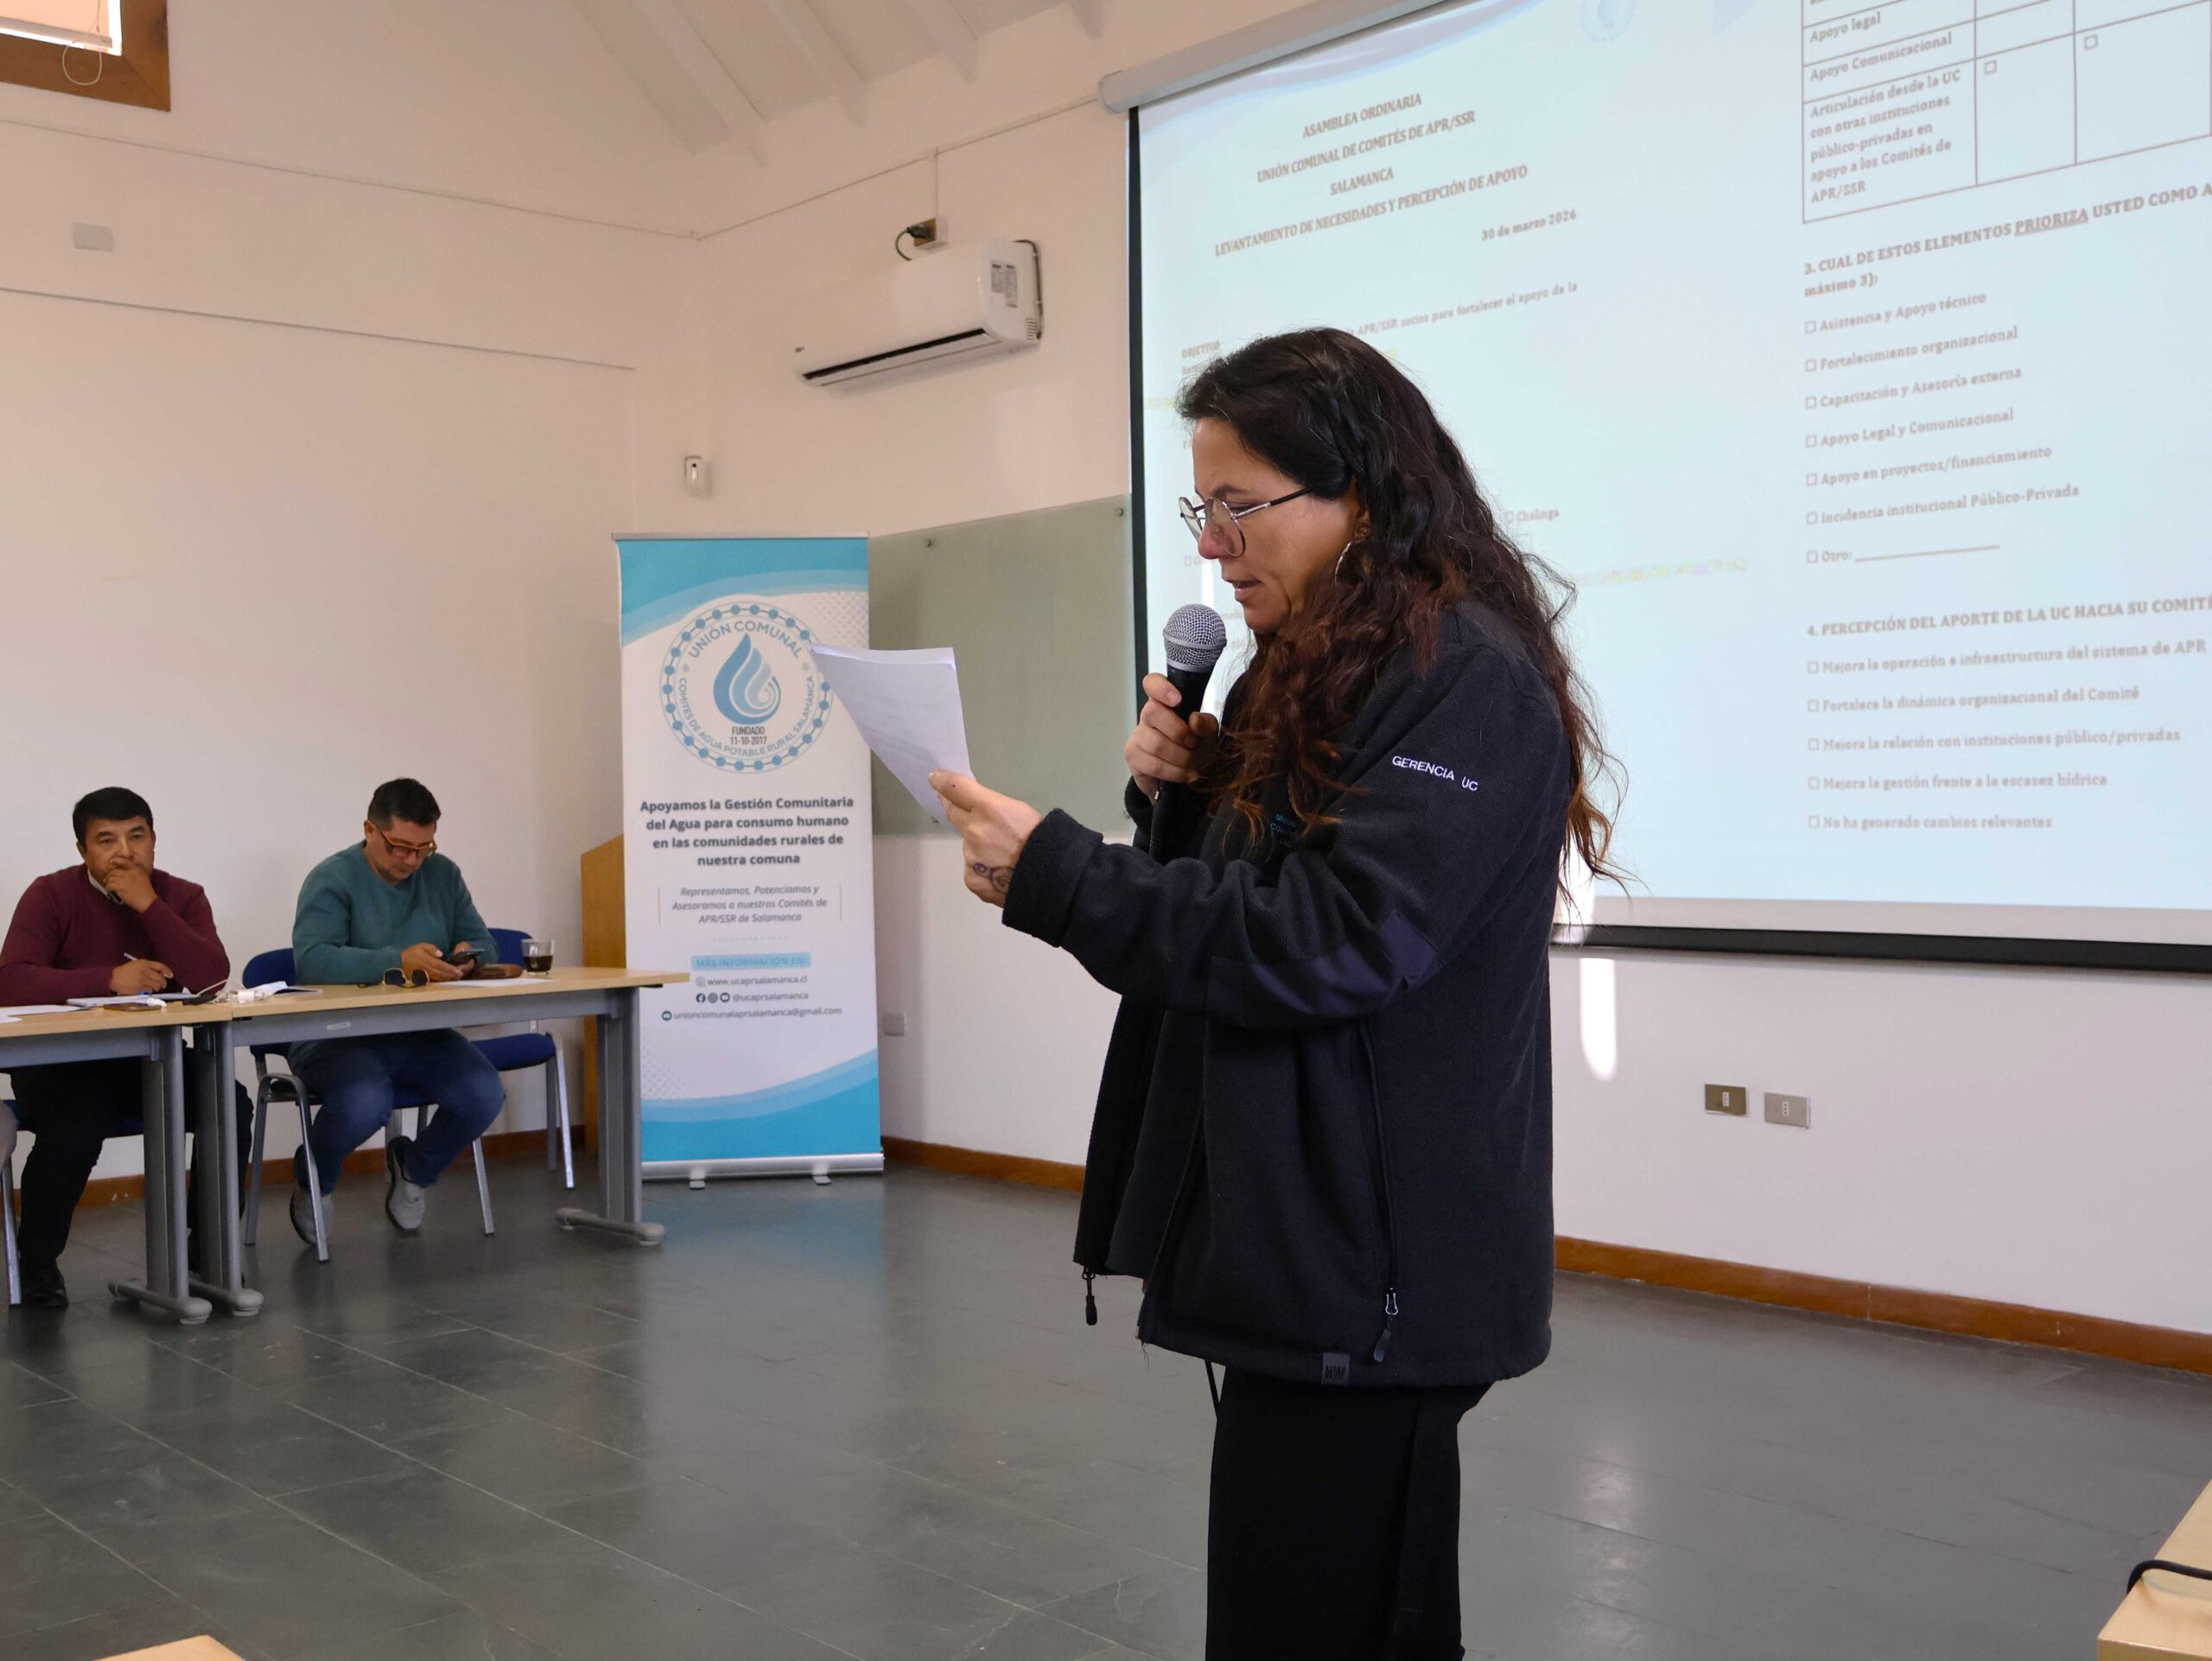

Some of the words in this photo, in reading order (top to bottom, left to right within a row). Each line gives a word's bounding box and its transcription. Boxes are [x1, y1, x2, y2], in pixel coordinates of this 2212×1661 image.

[1810, 23, 1848, 42] Apoyo
[1851, 10, 1880, 30] legal
[1810, 62, 1848, 80] Apoyo
[1852, 34, 1951, 69] Comunicacional
[1810, 90, 1884, 117] Articulación
[1887, 79, 1924, 99] desde
[1927, 75, 1939, 88] la
[1942, 68, 1960, 84] UC
[1302, 111, 1357, 137] ASAMBLEA
[1360, 93, 1421, 120] ORDINARIA
[1810, 125, 1832, 138] con
[1834, 117, 1866, 132] otras
[1869, 96, 1949, 124] instituciones
[1916, 124, 1932, 135] en
[1256, 162, 1289, 182] UNIÓN
[1291, 149, 1340, 173] COMUNAL
[1342, 143, 1357, 158] DE
[1358, 129, 1406, 153] COMITÉS
[1408, 124, 1424, 140] DE
[1425, 111, 1475, 135] APR/SSR
[1811, 164, 1847, 181] apoyo
[1850, 162, 1857, 172] a
[1859, 156, 1878, 169] los
[1881, 143, 1932, 164] Comités
[1936, 139, 1951, 152] de
[1330, 168, 1393, 194] SALAMANCA
[1811, 180, 1866, 202] APR/SSR
[1215, 224, 1297, 256] LEVANTAMIENTO
[1300, 220, 1313, 234] DE
[1315, 201, 1386, 229] NECESIDADES
[1388, 198, 1395, 212] Y
[1397, 181, 1465, 209] PERCEPCIÓN
[1468, 175, 1484, 191] DE
[1486, 164, 1528, 186] APOYO
[1481, 227, 1494, 240] 30
[1497, 224, 1510, 237] de
[1548, 208, 1576, 225] 2026
[1804, 263, 1815, 275] 3.
[1818, 255, 1853, 271] CUAL
[1856, 250, 1874, 264] DE
[1878, 240, 1921, 260] ESTOS
[1924, 223, 2011, 251] ELEMENTOS
[2014, 208, 2088, 236] PRIORIZA
[2092, 196, 2144, 217] USTED
[2148, 185, 2197, 206] COMO
[1804, 279, 1856, 296] máximo
[1820, 312, 1881, 331] Asistencia
[1884, 310, 1891, 322] y
[1895, 302, 1936, 319] Apoyo
[1939, 293, 1986, 309] técnico
[1820, 346, 1918, 369] Fortalecimiento
[1921, 325, 2018, 353] organizacional
[1820, 385, 1897, 407] Capacitación
[1901, 385, 1908, 398] y
[1911, 373, 1967, 393] Asesoría
[1970, 368, 2021, 385] externa
[1820, 432, 1859, 448] Apoyo
[1862, 423, 1895, 441] Legal
[1897, 425, 1905, 438] y
[1910, 407, 2013, 433] Comunicacional
[1821, 472, 1859, 487] Apoyo
[1862, 469, 1878, 480] en
[1821, 507, 1884, 523] Incidencia
[1887, 495, 1967, 516] institucional
[1807, 625, 1818, 636] 4.
[1821, 616, 1906, 634] PERCEPCIÓN
[1910, 615, 1937, 629] DEL
[1940, 611, 1999, 627] APORTE
[2003, 609, 2023, 623] DE
[2027, 608, 2046, 621] LA
[2050, 606, 2070, 620] UC
[2074, 602, 2124, 618] HACIA
[2127, 601, 2147, 614] SU
[734, 620, 802, 659] COMUNAL
[1822, 661, 1865, 673] Mejora
[1867, 658, 1878, 671] la
[1882, 654, 1946, 671] operación
[1948, 656, 1956, 666] e
[1960, 650, 2063, 665] infraestructura
[2066, 645, 2088, 659] del
[2092, 645, 2148, 659] sistema
[2152, 640, 2171, 655] de
[2174, 639, 2206, 653] APR
[1823, 698, 1879, 711] Fortalece
[1882, 696, 1893, 710] la
[1896, 695, 1955, 708] dinámica
[1959, 689, 2058, 708] organizacional
[2061, 687, 2084, 702] del
[2088, 685, 2139, 701] Comité
[698, 731, 722, 750] AGUA
[723, 746, 766, 757] POTABLE
[766, 732, 796, 752] RURAL
[793, 676, 815, 733] SALAMANCA
[733, 726, 765, 735] FUNDADO
[1823, 738, 1865, 751] Mejora
[1868, 735, 1879, 749] la
[1883, 735, 1934, 748] relación
[1937, 737, 1961, 747] con
[1964, 734, 2051, 746] instituciones
[1392, 755, 1455, 780] GERENCIA
[1461, 776, 1478, 791] UC
[1823, 777, 1866, 791] Mejora
[1868, 775, 1879, 788] la
[1883, 775, 1929, 791] gestión
[1932, 773, 1972, 787] frente
[1975, 777, 1982, 787] a
[1986, 773, 1998, 786] la
[2001, 776, 2053, 786] escasez
[2056, 772, 2107, 786] hídrica
[639, 801, 706, 813] Apoyamos
[709, 799, 721, 810] la
[724, 798, 772, 810] Gestión
[775, 797, 853, 808] Comunitaria
[646, 818, 665, 830] del
[669, 818, 700, 832] Agua
[704, 819, 733, 830] para
[736, 818, 793, 828] consumo
[797, 816, 849, 826] humano
[1823, 816, 1840, 828] No
[1843, 815, 1858, 828] ha
[1861, 814, 1920, 830] generado
[1923, 815, 1977, 828] cambios
[1980, 814, 2051, 828] relevantes
[652, 839, 668, 849] en
[671, 837, 690, 848] las
[693, 835, 777, 847] comunidades
[780, 834, 824, 845] rurales
[828, 833, 843, 844] de
[697, 856, 746, 865] nuestra
[749, 855, 800, 864] comuna
[671, 901, 726, 910] Asesoramos
[778, 898, 813, 907] Comités
[816, 898, 827, 907] de
[753, 885, 810, 894] Potenciamos
[812, 886, 819, 895] y
[698, 913, 736, 923] APR/SSR
[738, 913, 749, 923] de
[752, 913, 802, 922] Salamanca
